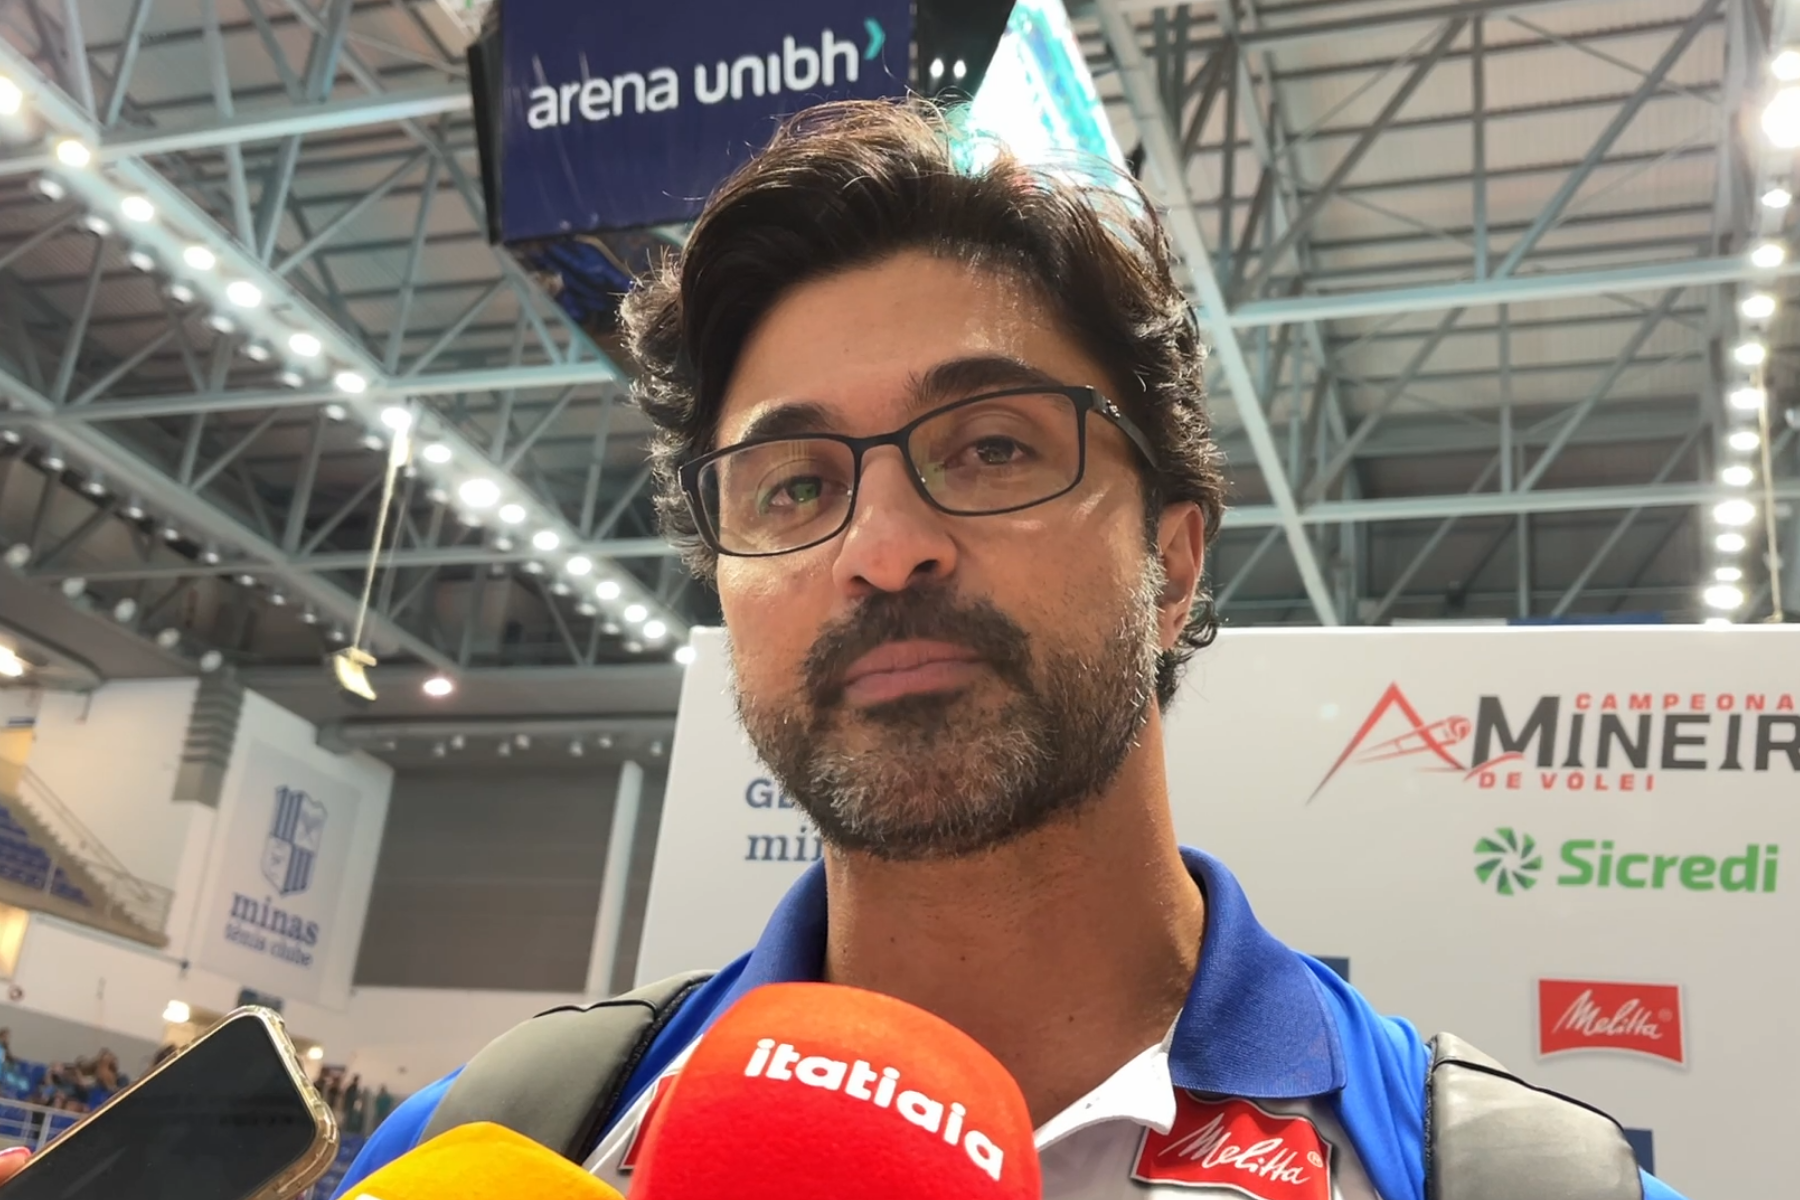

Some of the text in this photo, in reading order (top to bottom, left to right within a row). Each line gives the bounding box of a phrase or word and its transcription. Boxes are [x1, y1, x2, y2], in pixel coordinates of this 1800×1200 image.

[528, 29, 859, 129] arena unibh
[1575, 693, 1794, 711] CAMPEONA
[1478, 772, 1522, 789] DE
[1557, 840, 1779, 892] Sicredi
[230, 893, 319, 946] minas
[744, 1038, 1004, 1182] itatiaia
